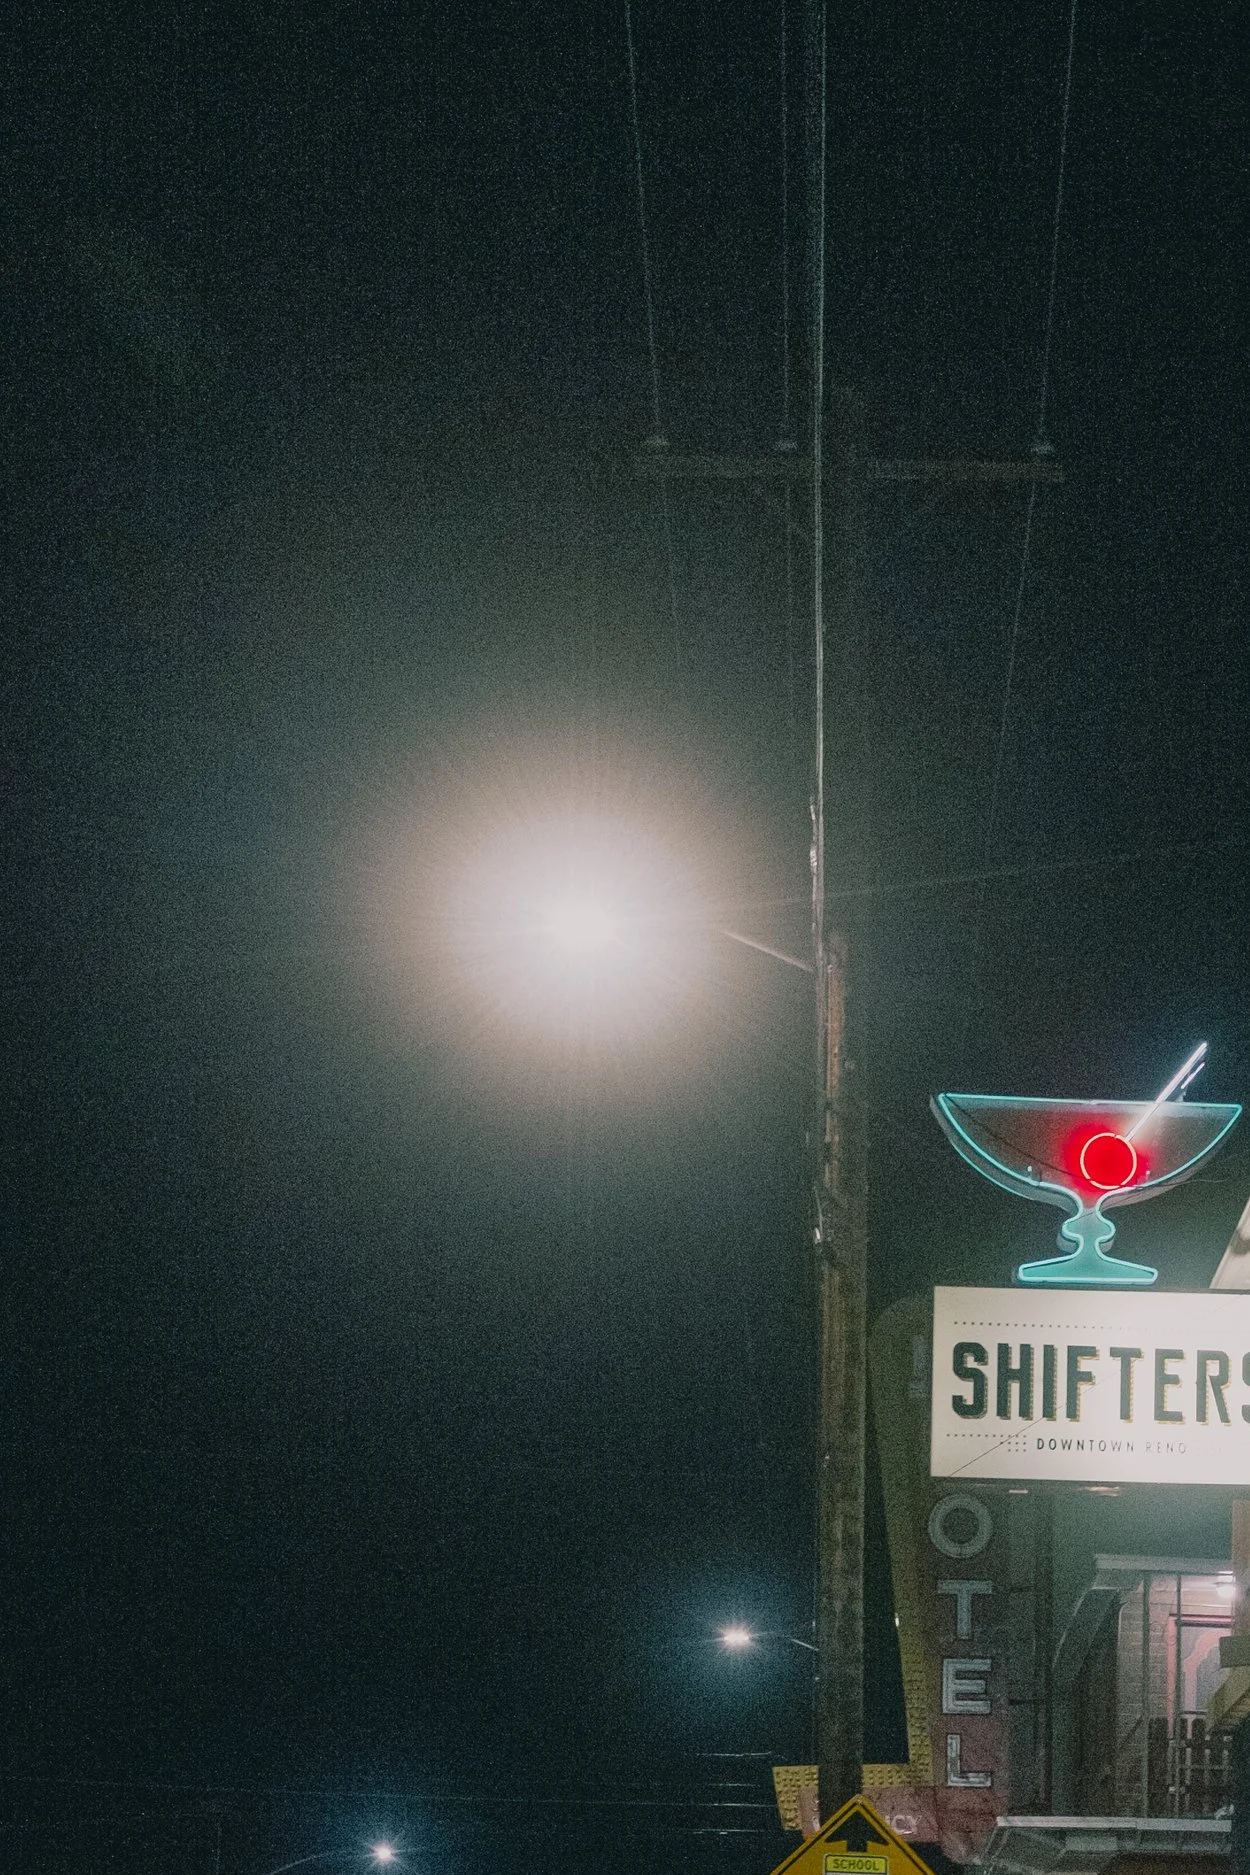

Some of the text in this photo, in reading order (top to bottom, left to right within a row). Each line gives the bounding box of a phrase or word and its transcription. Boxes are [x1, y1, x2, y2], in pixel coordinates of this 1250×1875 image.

[1036, 1437, 1188, 1455] DOWNTOWN RENO
[928, 1493, 993, 1788] OTEL
[833, 1858, 879, 1871] SCHOOL
